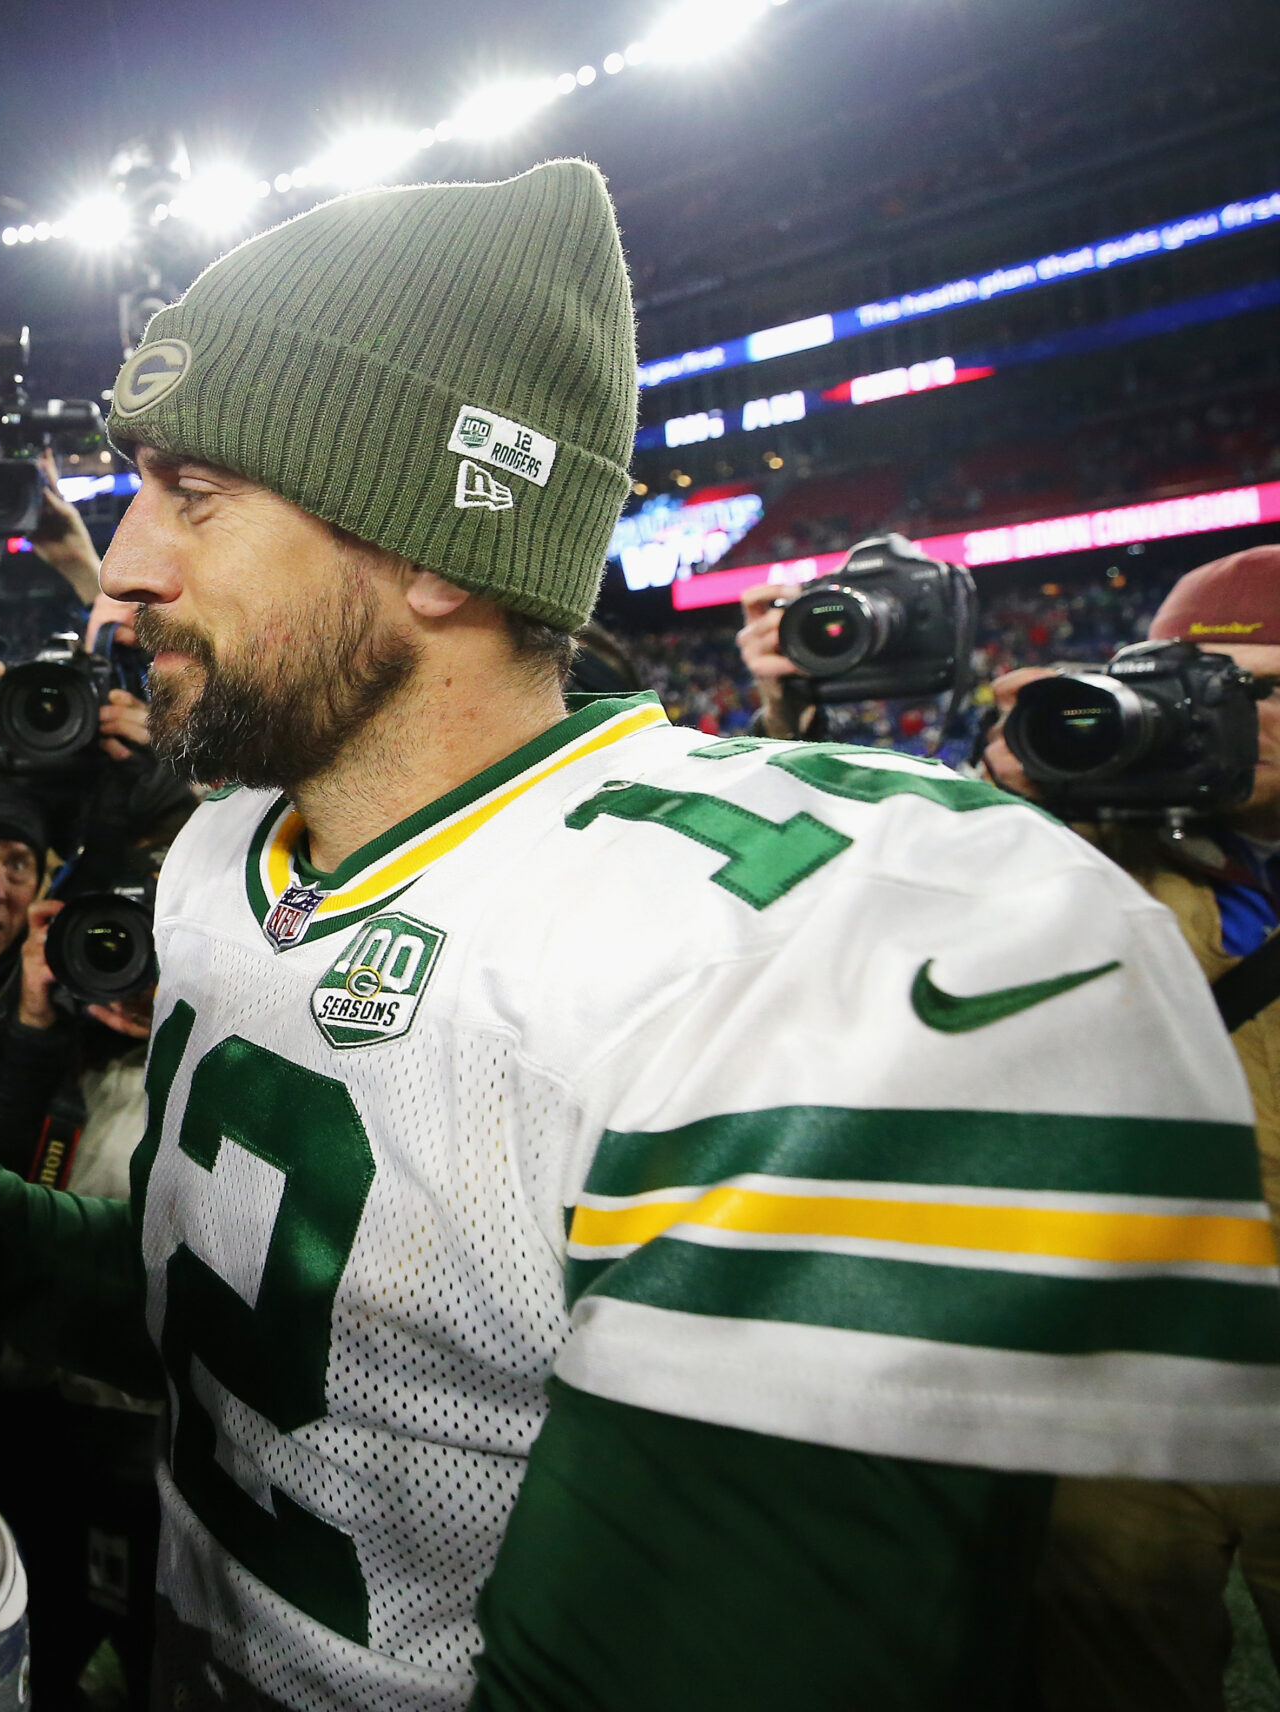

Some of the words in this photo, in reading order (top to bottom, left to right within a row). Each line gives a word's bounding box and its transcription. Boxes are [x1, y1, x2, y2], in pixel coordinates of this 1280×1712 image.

[463, 419, 489, 436] 100
[514, 430, 533, 453] 12
[491, 442, 542, 478] RODGERS
[1111, 661, 1156, 674] Nikon
[268, 905, 301, 937] NFL
[333, 926, 426, 994] 100
[318, 995, 401, 1027] SEASONS
[39, 1140, 66, 1190] non
